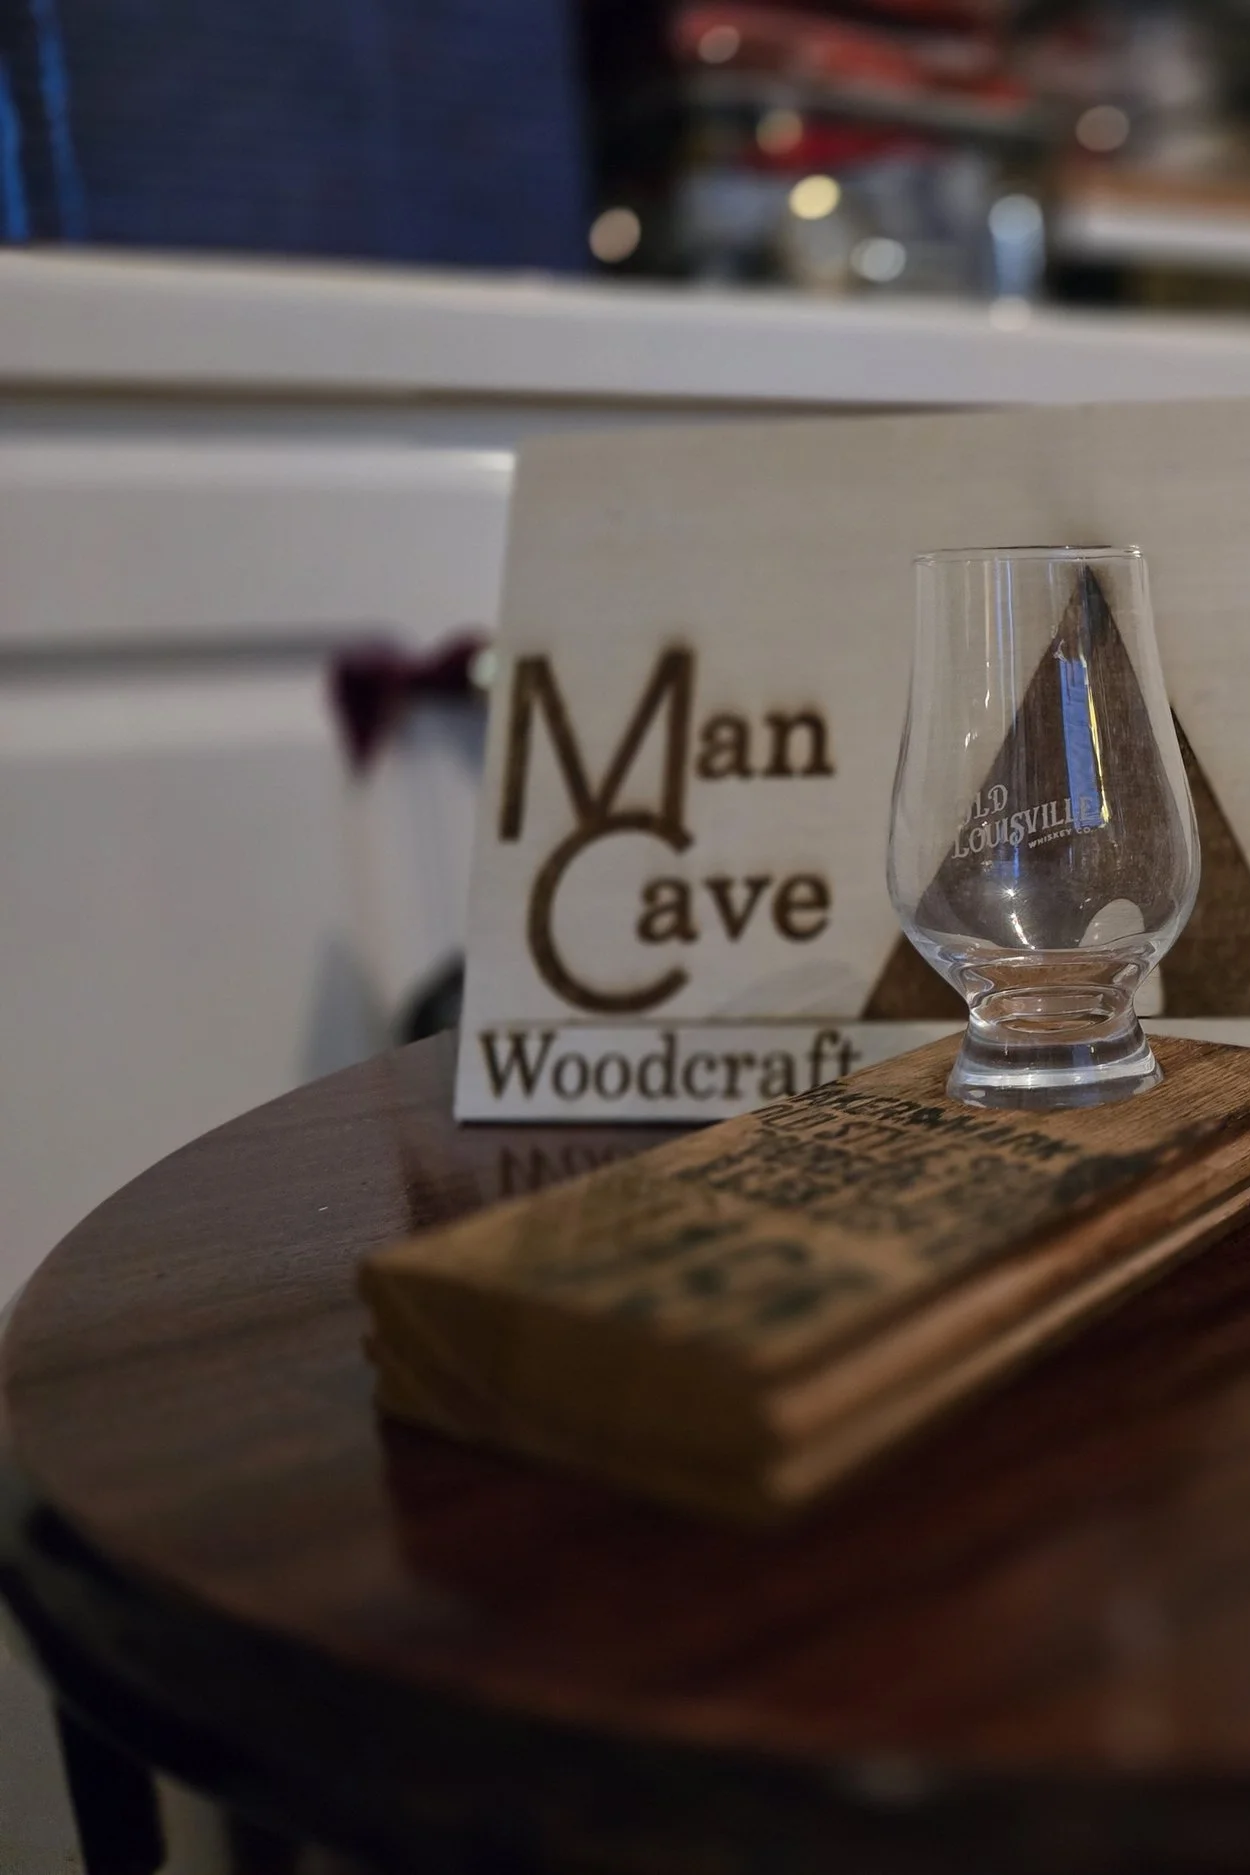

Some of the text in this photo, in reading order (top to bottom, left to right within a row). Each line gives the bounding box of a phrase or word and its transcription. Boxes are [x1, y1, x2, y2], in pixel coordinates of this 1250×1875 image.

[498, 644, 835, 843] Man
[951, 795, 1098, 860] LOUISVILLE
[1028, 827, 1073, 849] WHISKEY
[526, 808, 833, 1016] Cave
[479, 1028, 862, 1101] Woodcraft
